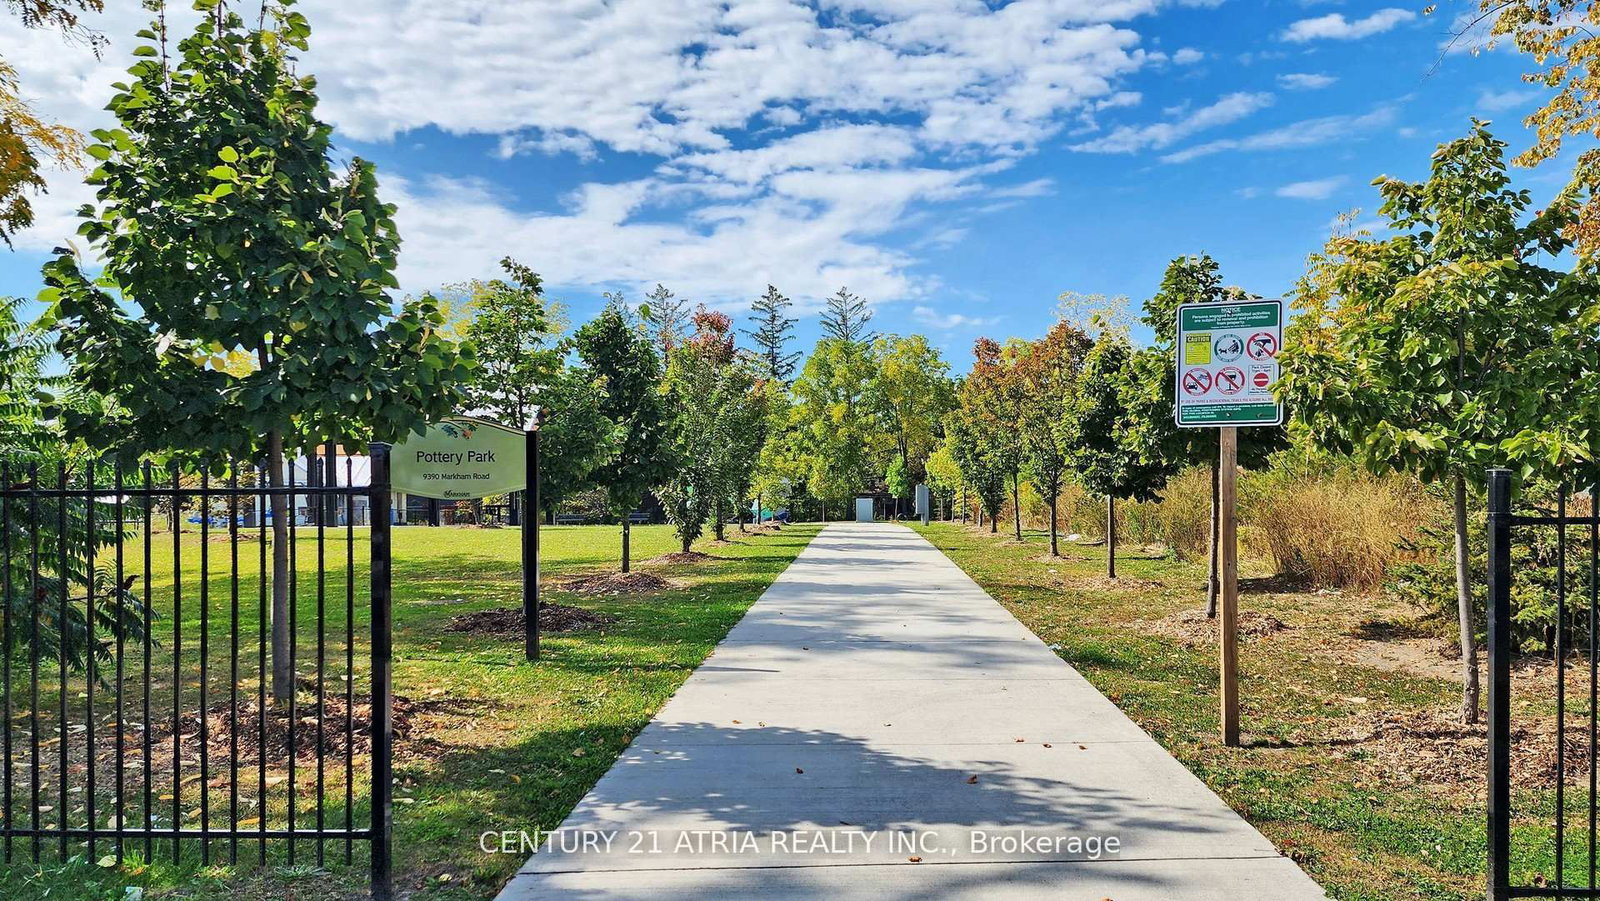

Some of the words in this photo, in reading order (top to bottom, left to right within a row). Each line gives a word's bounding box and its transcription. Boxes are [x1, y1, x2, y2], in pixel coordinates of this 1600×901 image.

[416, 451, 463, 466] Pottery
[468, 450, 496, 462] Park
[442, 472, 472, 480] Markham
